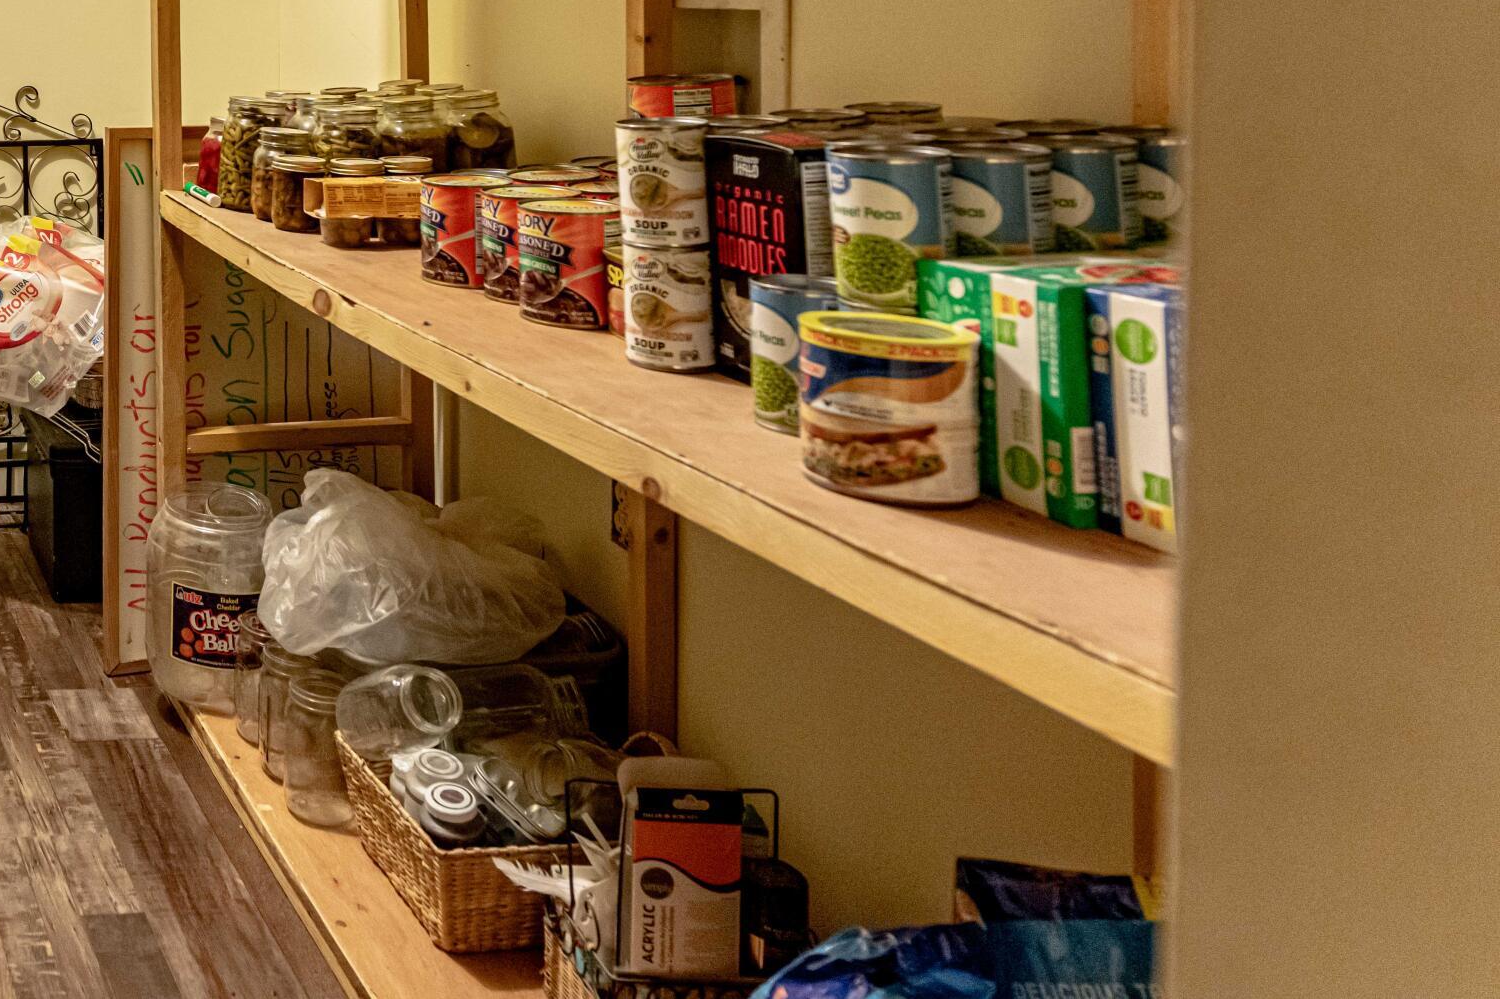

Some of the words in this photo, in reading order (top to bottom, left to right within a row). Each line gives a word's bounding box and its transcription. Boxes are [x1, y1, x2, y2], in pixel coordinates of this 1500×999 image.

[628, 164, 670, 179] ORGANIC
[715, 182, 785, 205] organic
[1051, 198, 1078, 211] eas
[715, 195, 786, 244] RAMEN
[863, 205, 903, 221] Peas
[635, 219, 669, 231] SOUP
[3, 252, 24, 266] 2
[716, 232, 788, 276] NOODLES
[9, 279, 30, 297] ULTRA
[630, 285, 669, 299] ORGANIC
[634, 337, 666, 351] SOUP
[759, 330, 787, 348] Peas
[641, 904, 656, 964] ACRYLIC
